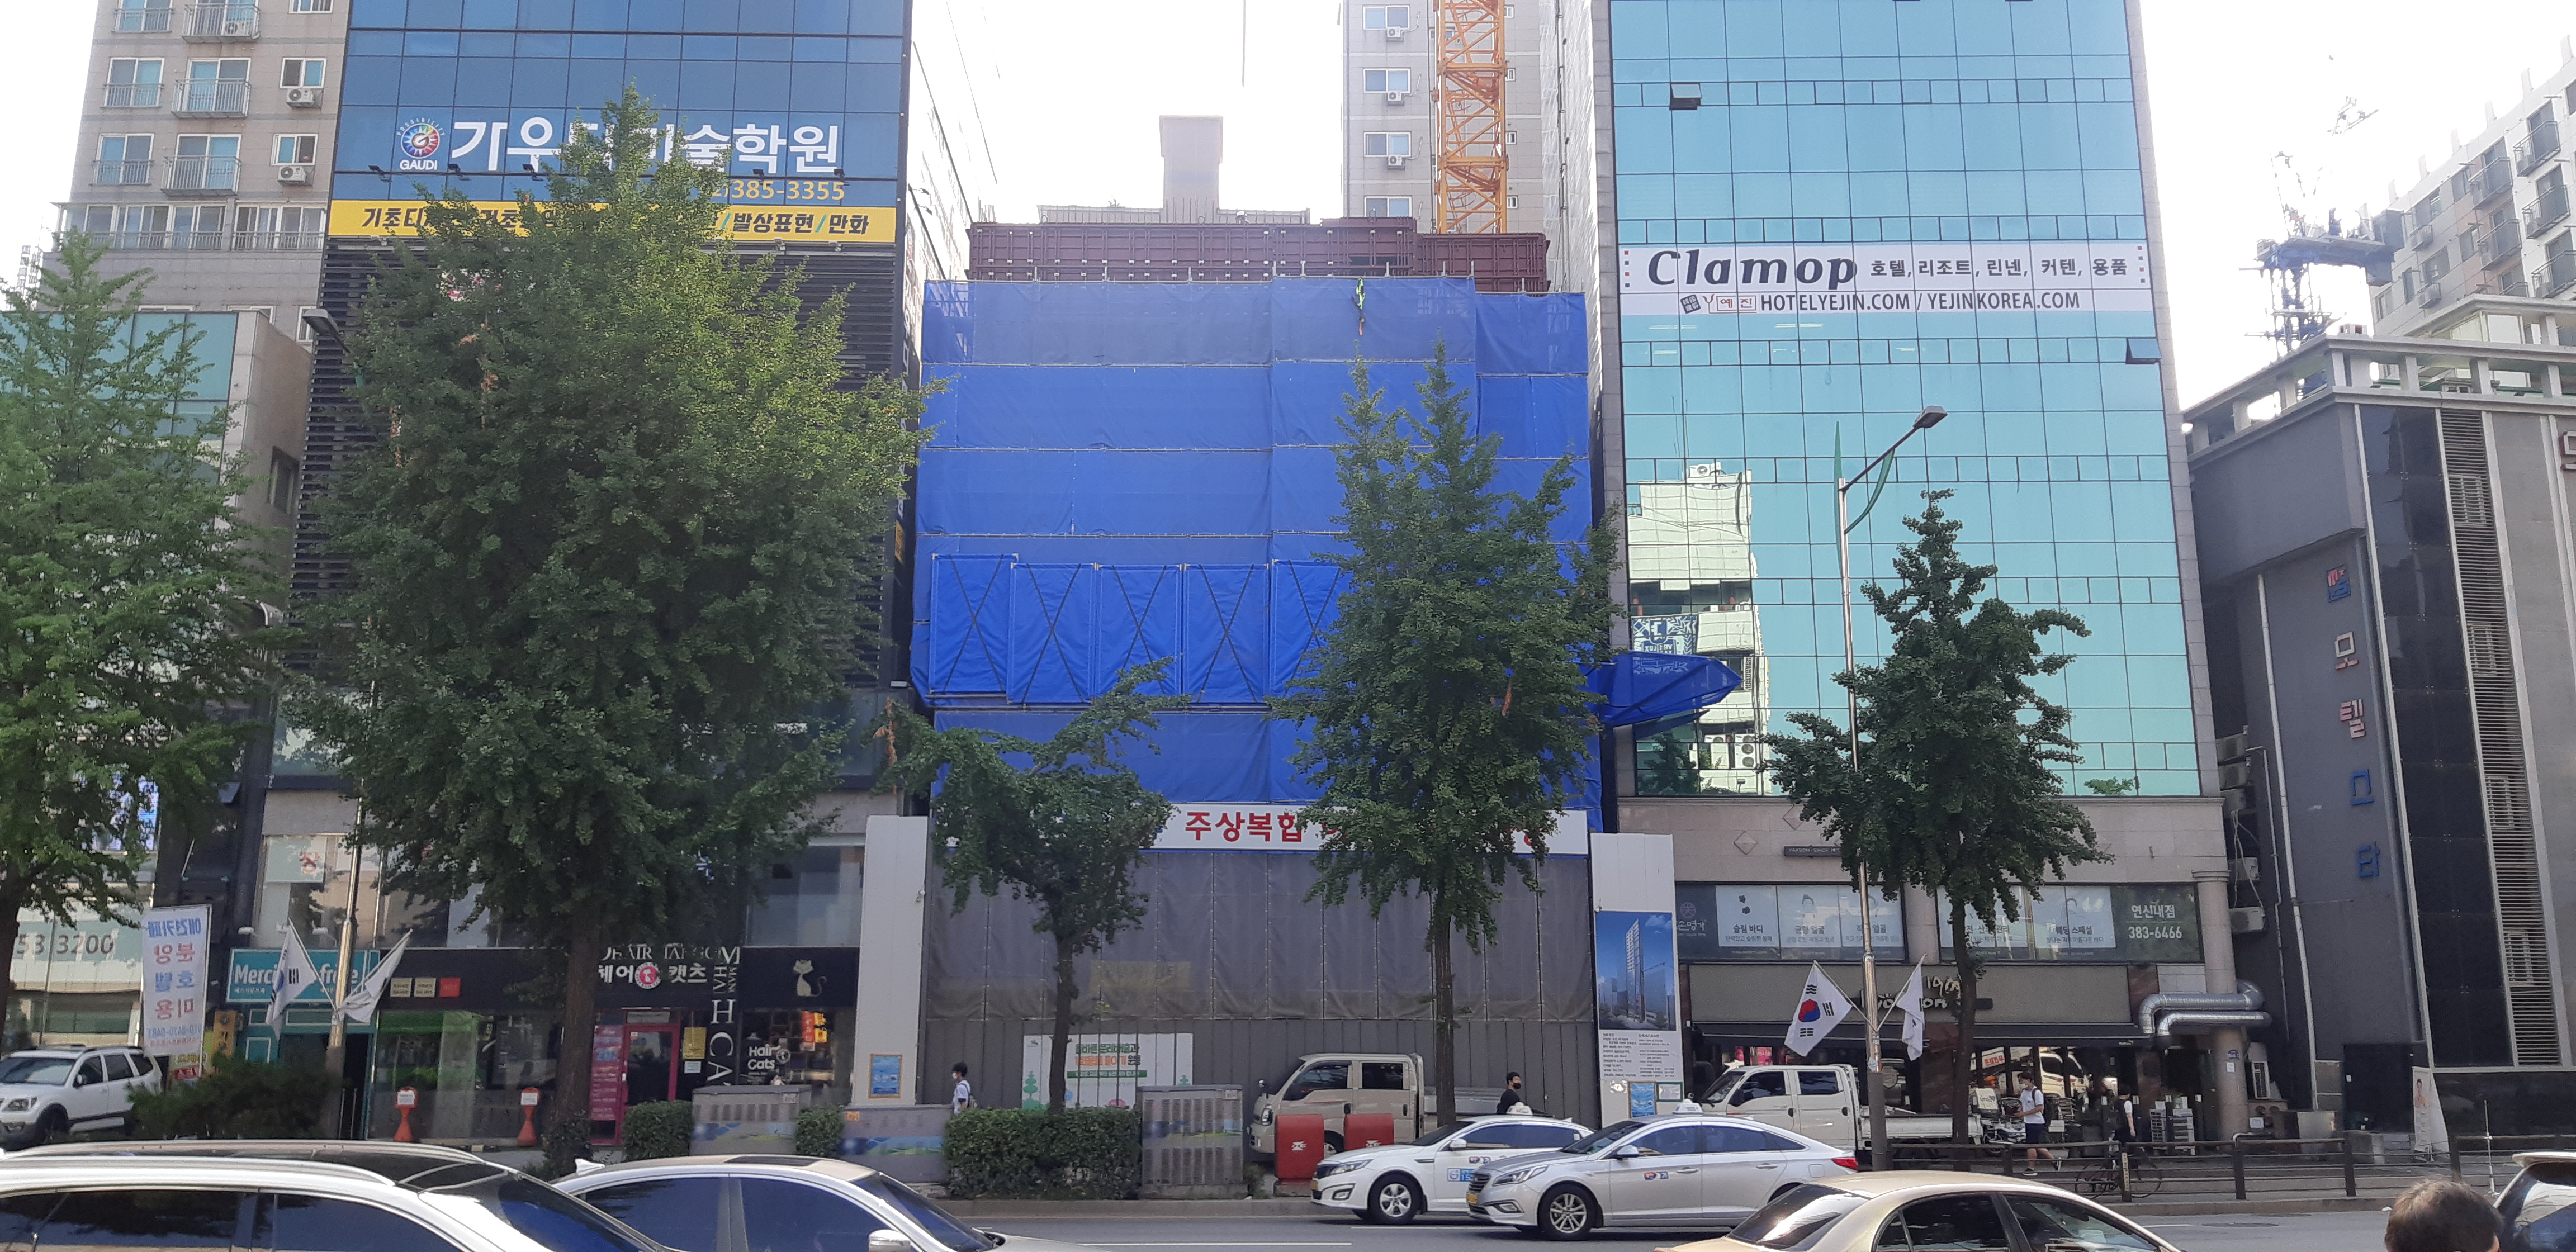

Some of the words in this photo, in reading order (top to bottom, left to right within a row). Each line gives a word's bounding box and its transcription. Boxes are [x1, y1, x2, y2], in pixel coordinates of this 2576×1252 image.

[400, 159, 438, 170] GAUDI
[733, 212, 815, 233] 발상표현
[828, 215, 870, 235] 만화
[1648, 249, 1858, 290] Clamop
[1871, 259, 1912, 278] 호텔,
[1918, 259, 1980, 277] 리조트,
[2042, 258, 2083, 277] 커텐,
[2092, 258, 2128, 276] 용품
[1761, 293, 1910, 311] HOTELYEJIN.COM
[1927, 292, 2080, 310] YEJINKOREA.COM
[1185, 811, 1303, 842] 주상복합
[2131, 904, 2176, 918] 연신내점
[1677, 919, 1706, 931] 손명가
[1733, 924, 1748, 933] 슬림
[1749, 924, 1764, 933] 바디
[1811, 925, 1825, 935] 얼굴
[1872, 924, 1886, 933] 얼굴
[2071, 926, 2093, 935] 스페셜
[2128, 926, 2182, 940] 383-6466
[56, 933, 114, 955] 3200
[669, 963, 708, 983] 캣츠
[749, 1044, 782, 1057] Hair
[747, 1059, 775, 1070] Cats
